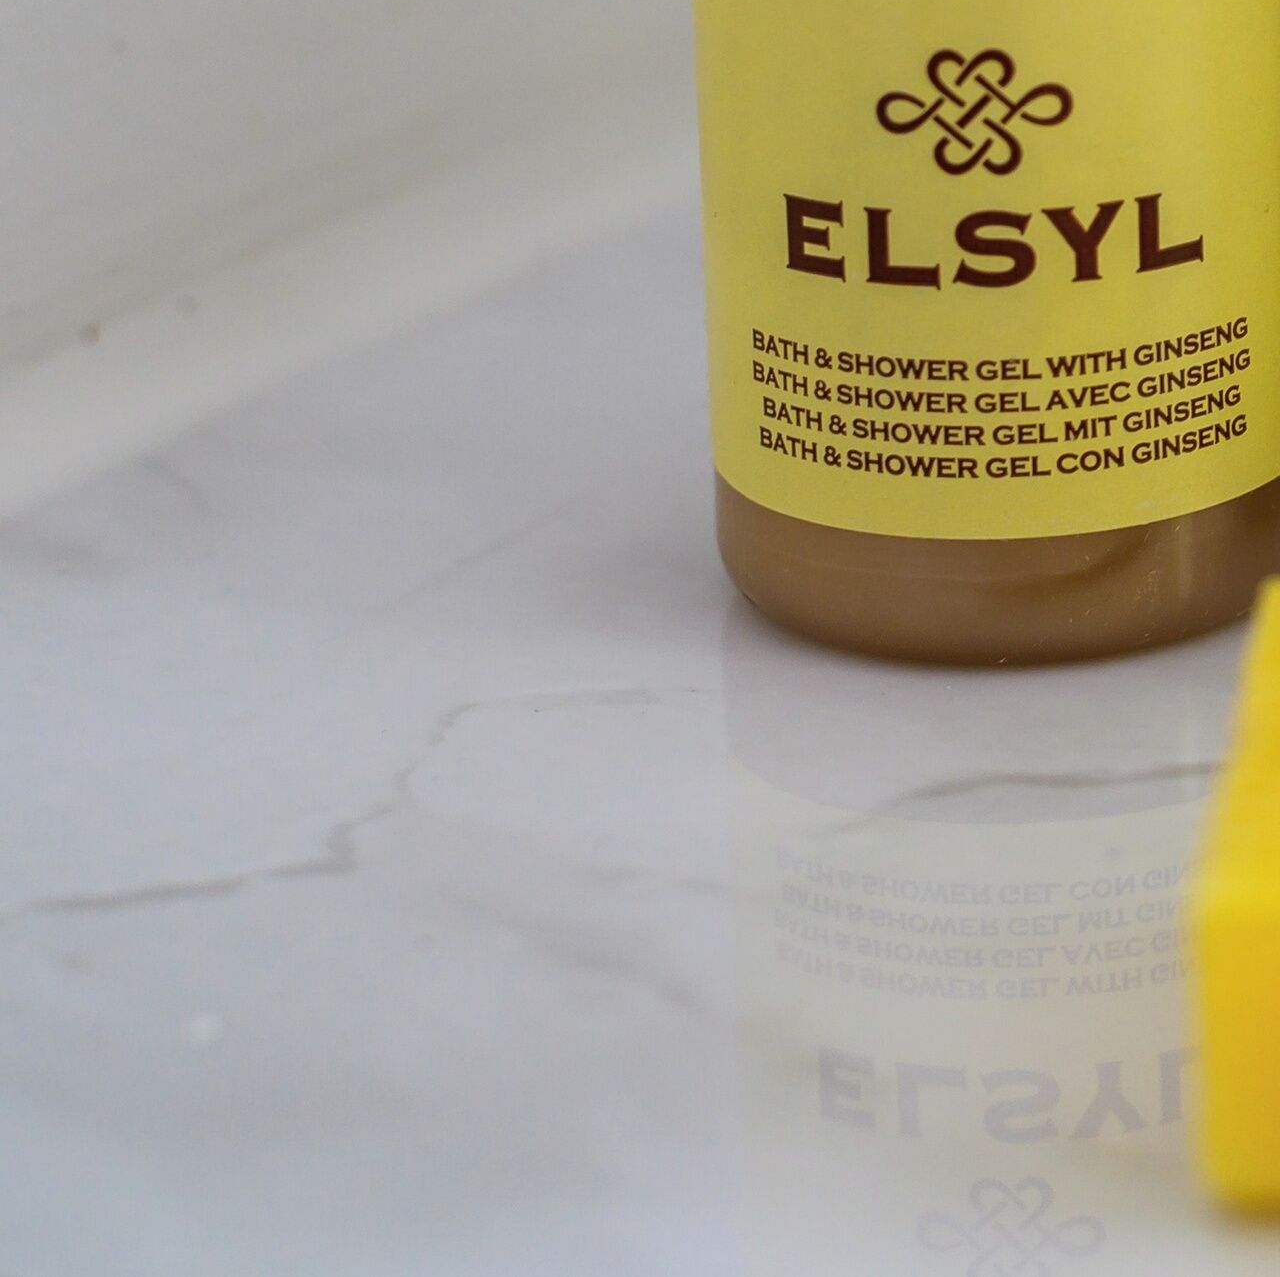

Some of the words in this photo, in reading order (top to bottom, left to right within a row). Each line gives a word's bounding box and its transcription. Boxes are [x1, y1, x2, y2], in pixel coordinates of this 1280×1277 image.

[783, 193, 1204, 290] ELSYL
[752, 328, 810, 366] BATH
[814, 347, 833, 370] &
[837, 351, 970, 382] SHOWER
[975, 358, 1043, 382] GEL
[1045, 347, 1127, 379] WITH
[1133, 316, 1248, 367] GINSENG
[752, 359, 809, 397] BATH
[813, 379, 832, 402] &
[836, 383, 968, 414] SHOWER
[974, 391, 1041, 414] GEL
[1045, 381, 1132, 411] AVEC
[1136, 348, 1251, 398] GINSENG
[759, 425, 818, 463] BATH
[823, 445, 842, 468] &
[846, 449, 980, 479] SHOWER
[984, 455, 1052, 479] GEL
[1056, 445, 1125, 475] CON
[1131, 414, 1248, 465] GINSENG
[762, 395, 823, 432] BATH
[828, 414, 847, 437] &
[852, 418, 986, 446] SHOWER
[992, 422, 1059, 446] GEL
[1064, 414, 1118, 442] MIT
[1122, 384, 1241, 433] GINSENG
